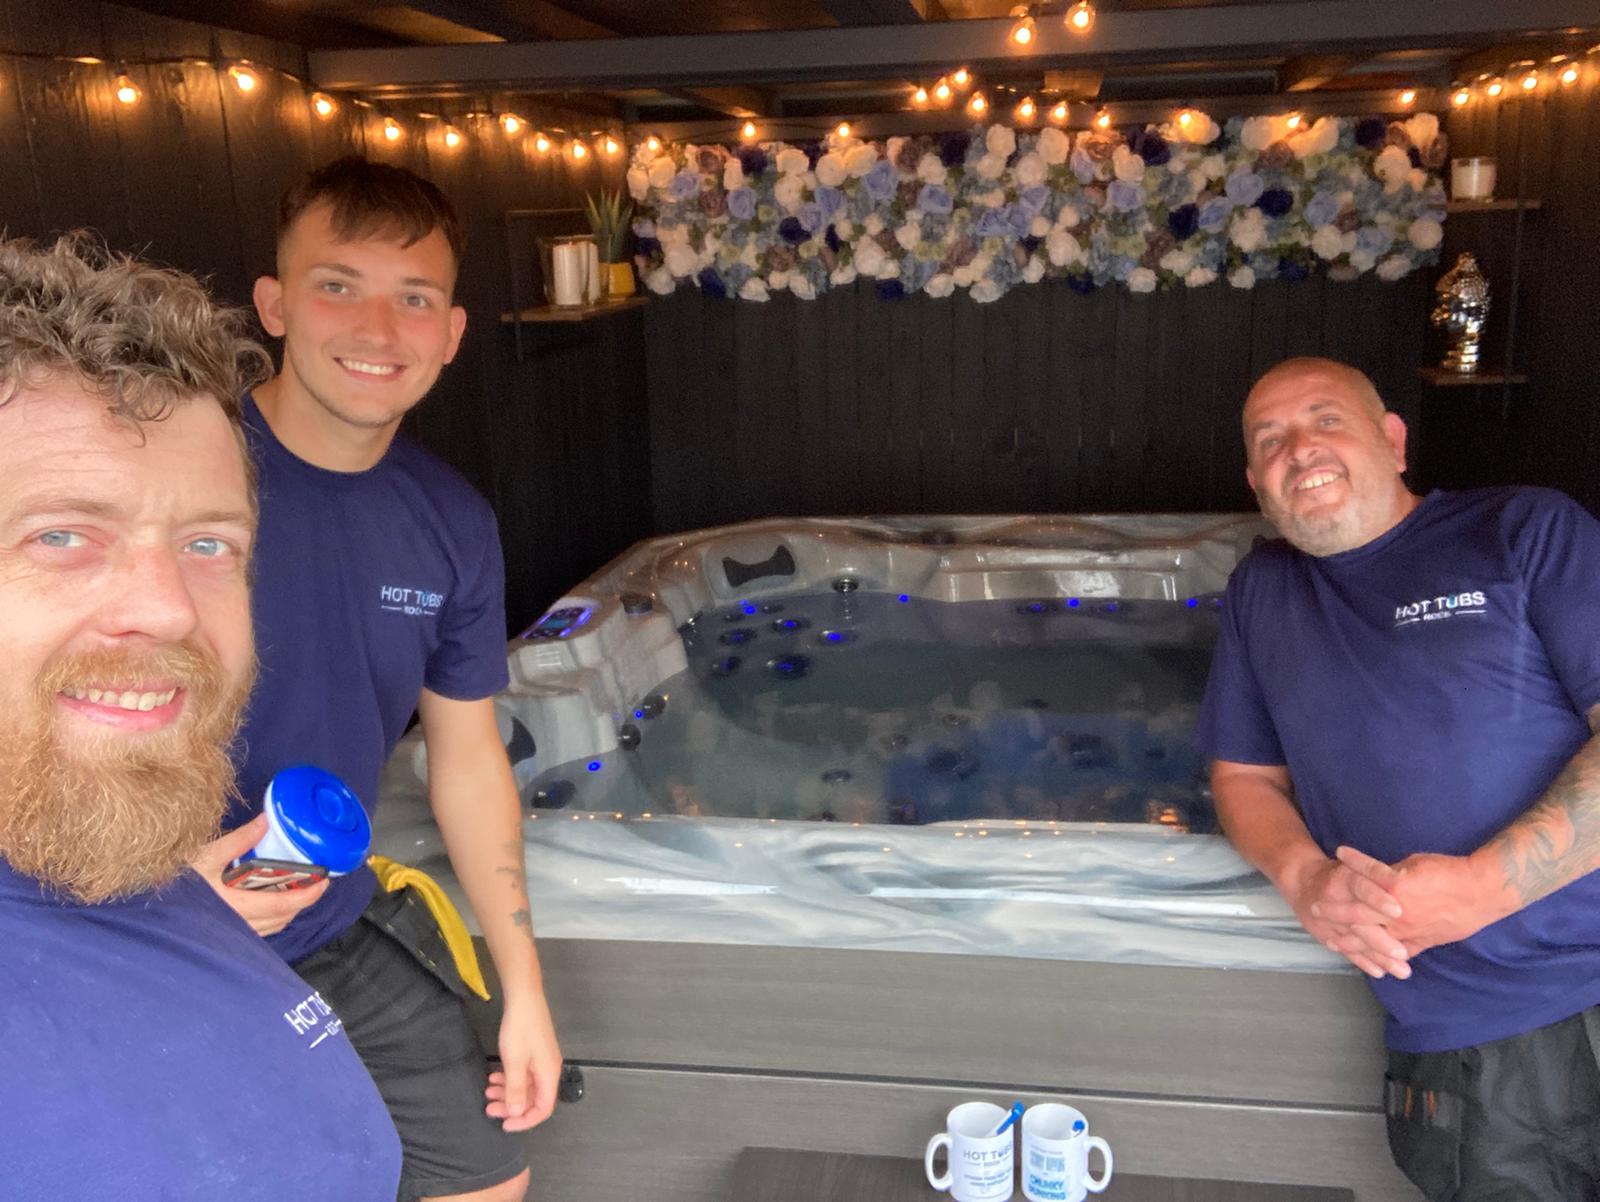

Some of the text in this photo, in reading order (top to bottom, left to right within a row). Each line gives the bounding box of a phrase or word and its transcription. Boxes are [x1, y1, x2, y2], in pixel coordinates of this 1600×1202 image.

[381, 585, 443, 608] HOT TUBS
[1395, 591, 1486, 619] HOT TUBS
[963, 1150, 988, 1161] HOT
